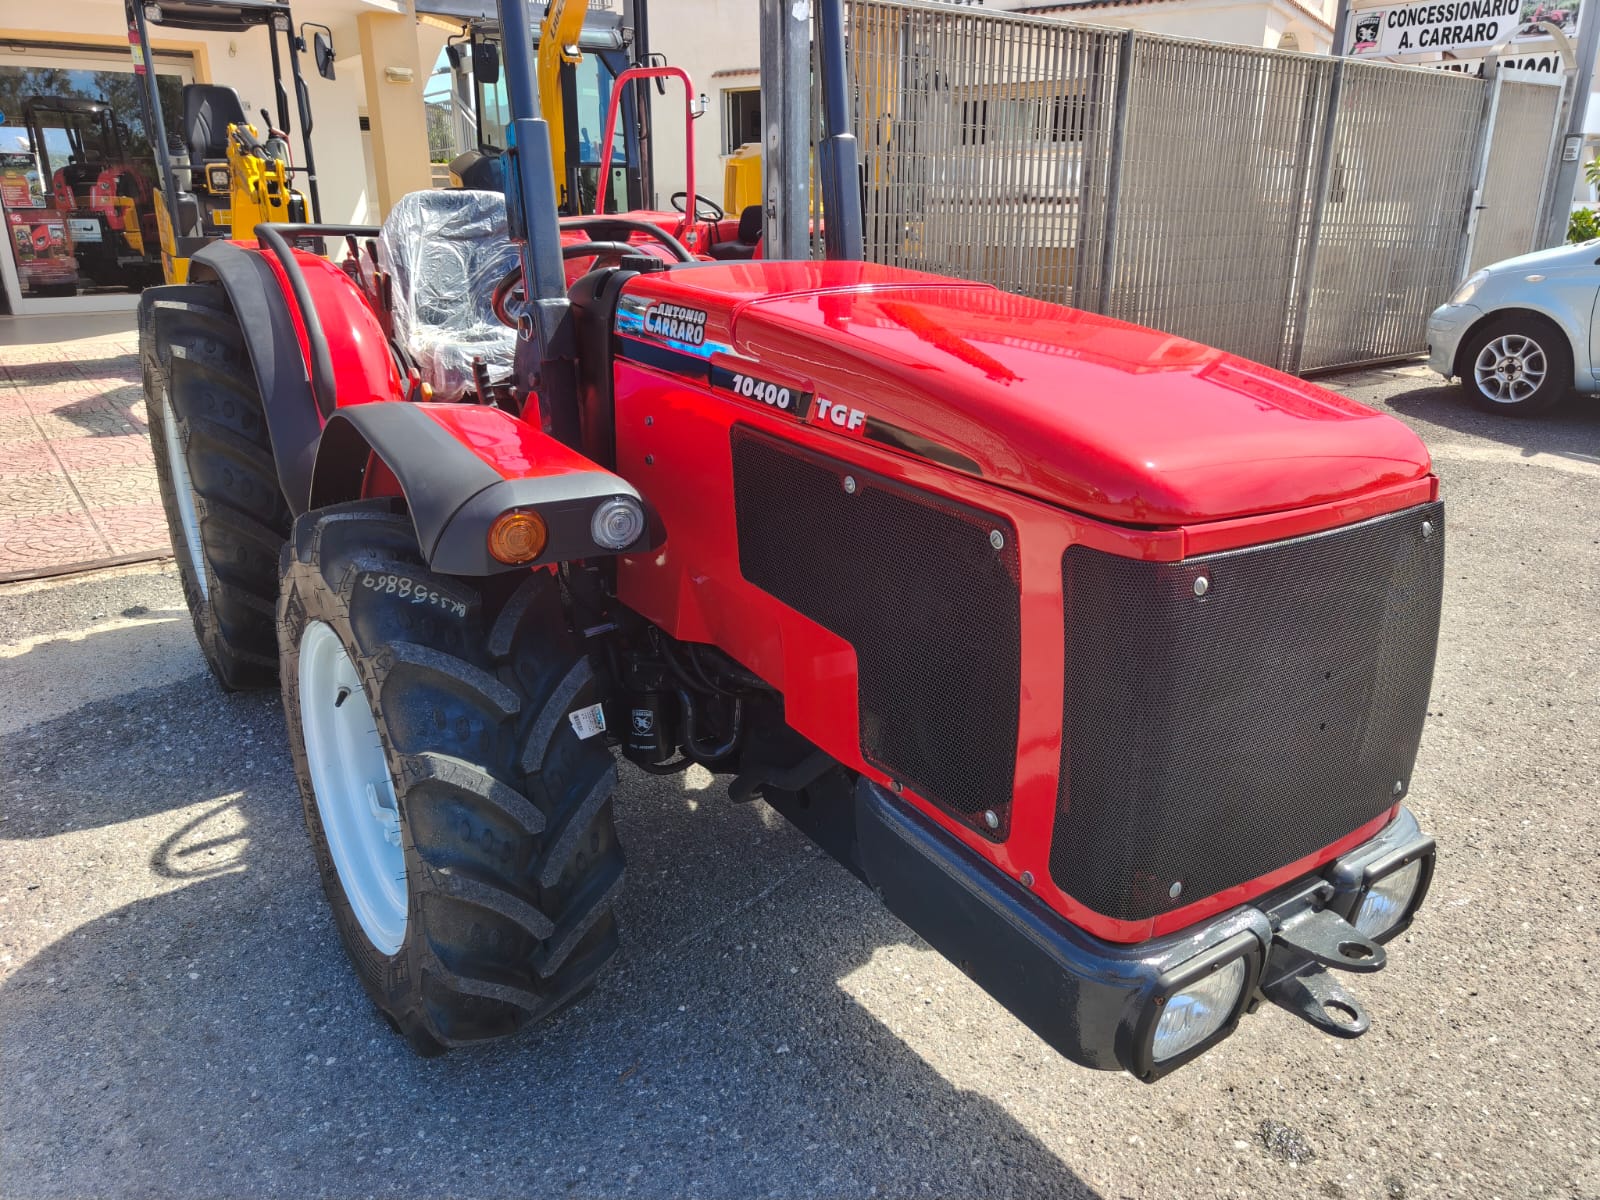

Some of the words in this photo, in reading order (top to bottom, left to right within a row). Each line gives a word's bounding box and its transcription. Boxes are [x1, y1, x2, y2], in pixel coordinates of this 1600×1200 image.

[1388, 0, 1519, 28] CONCESSIONARIO
[1398, 31, 1413, 49] A.
[1419, 21, 1499, 47] CARRARO
[644, 306, 704, 345] CARRARO
[657, 303, 706, 325] ANTONIO
[733, 374, 790, 409] 10400
[816, 397, 866, 430] TGF
